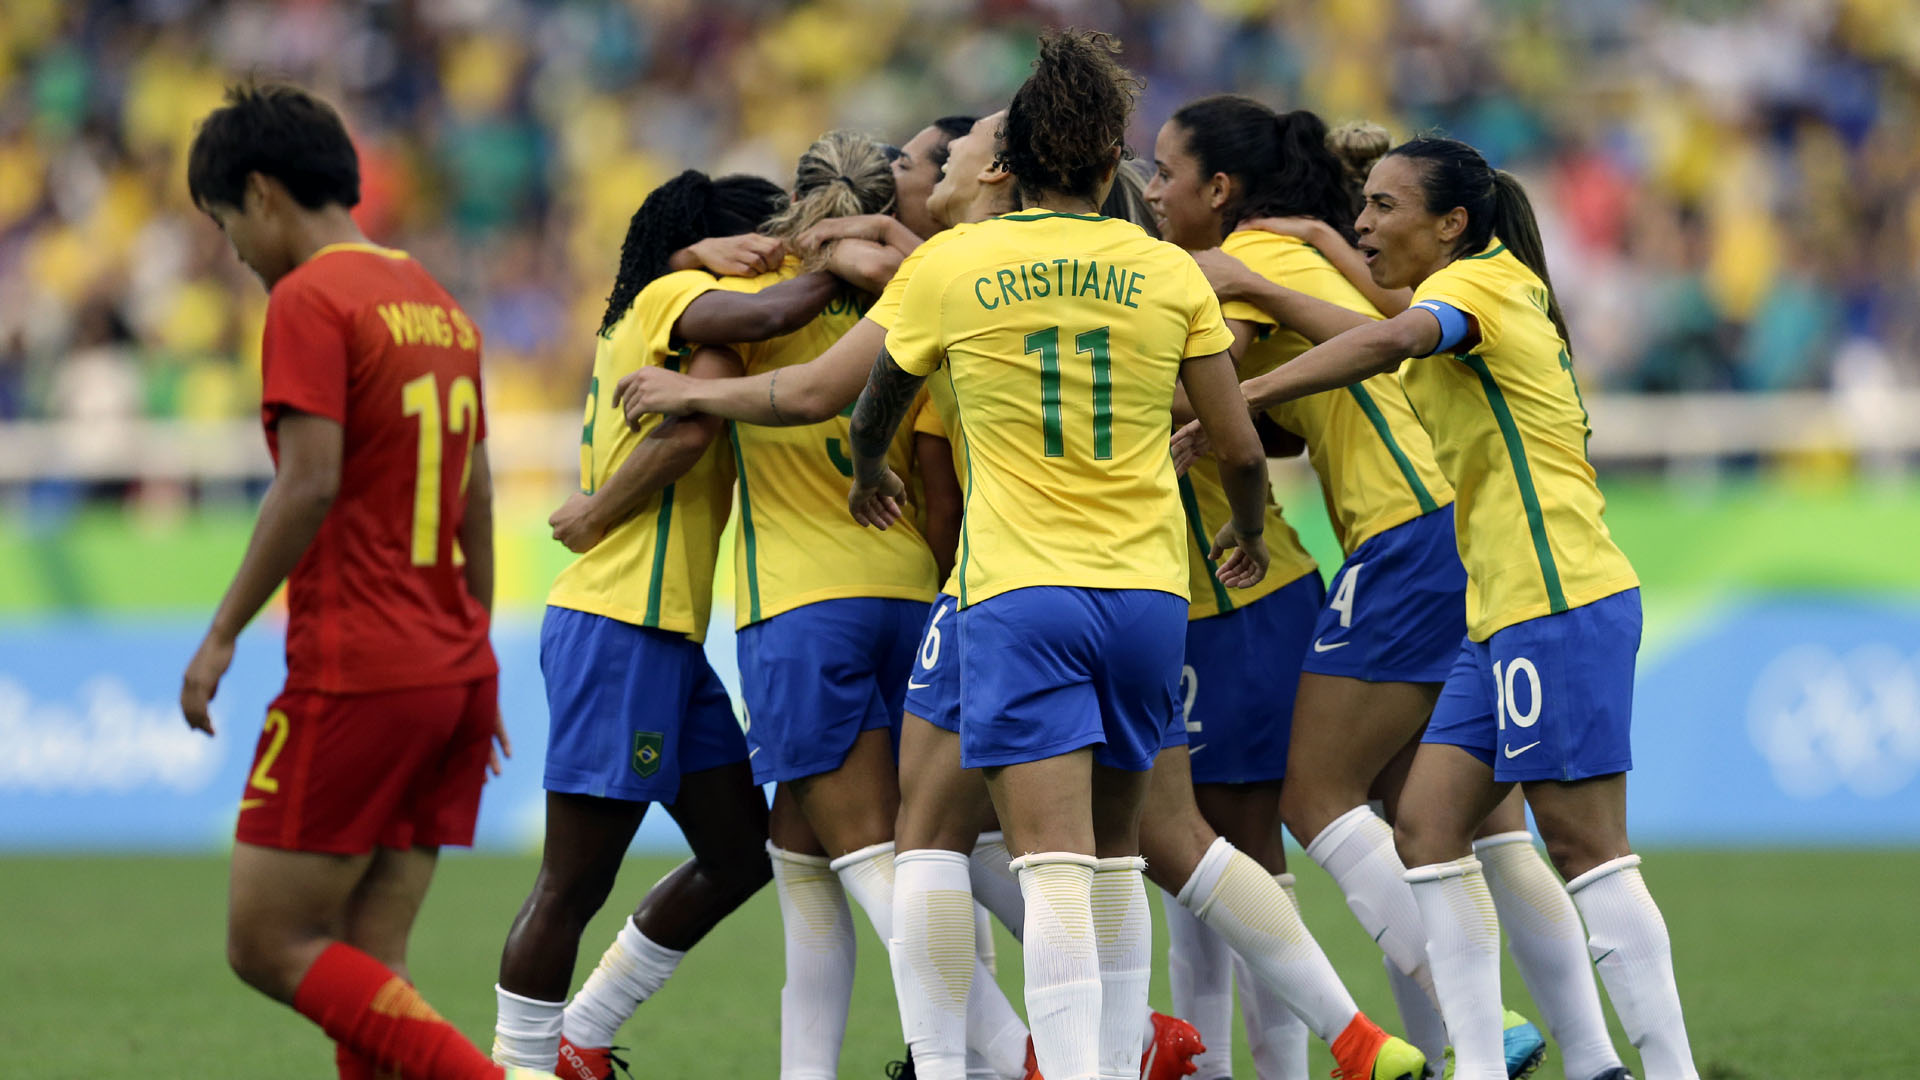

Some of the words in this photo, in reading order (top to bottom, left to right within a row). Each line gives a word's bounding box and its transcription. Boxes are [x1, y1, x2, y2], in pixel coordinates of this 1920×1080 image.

[974, 258, 1146, 310] CRISTIANE
[377, 301, 453, 348] WANG
[1023, 325, 1112, 460] 11
[402, 372, 479, 567] 12
[1329, 563, 1364, 628] 4
[915, 603, 949, 671] 6
[1179, 663, 1203, 733] 2
[1492, 656, 1543, 730] 10
[250, 708, 290, 794] 2
